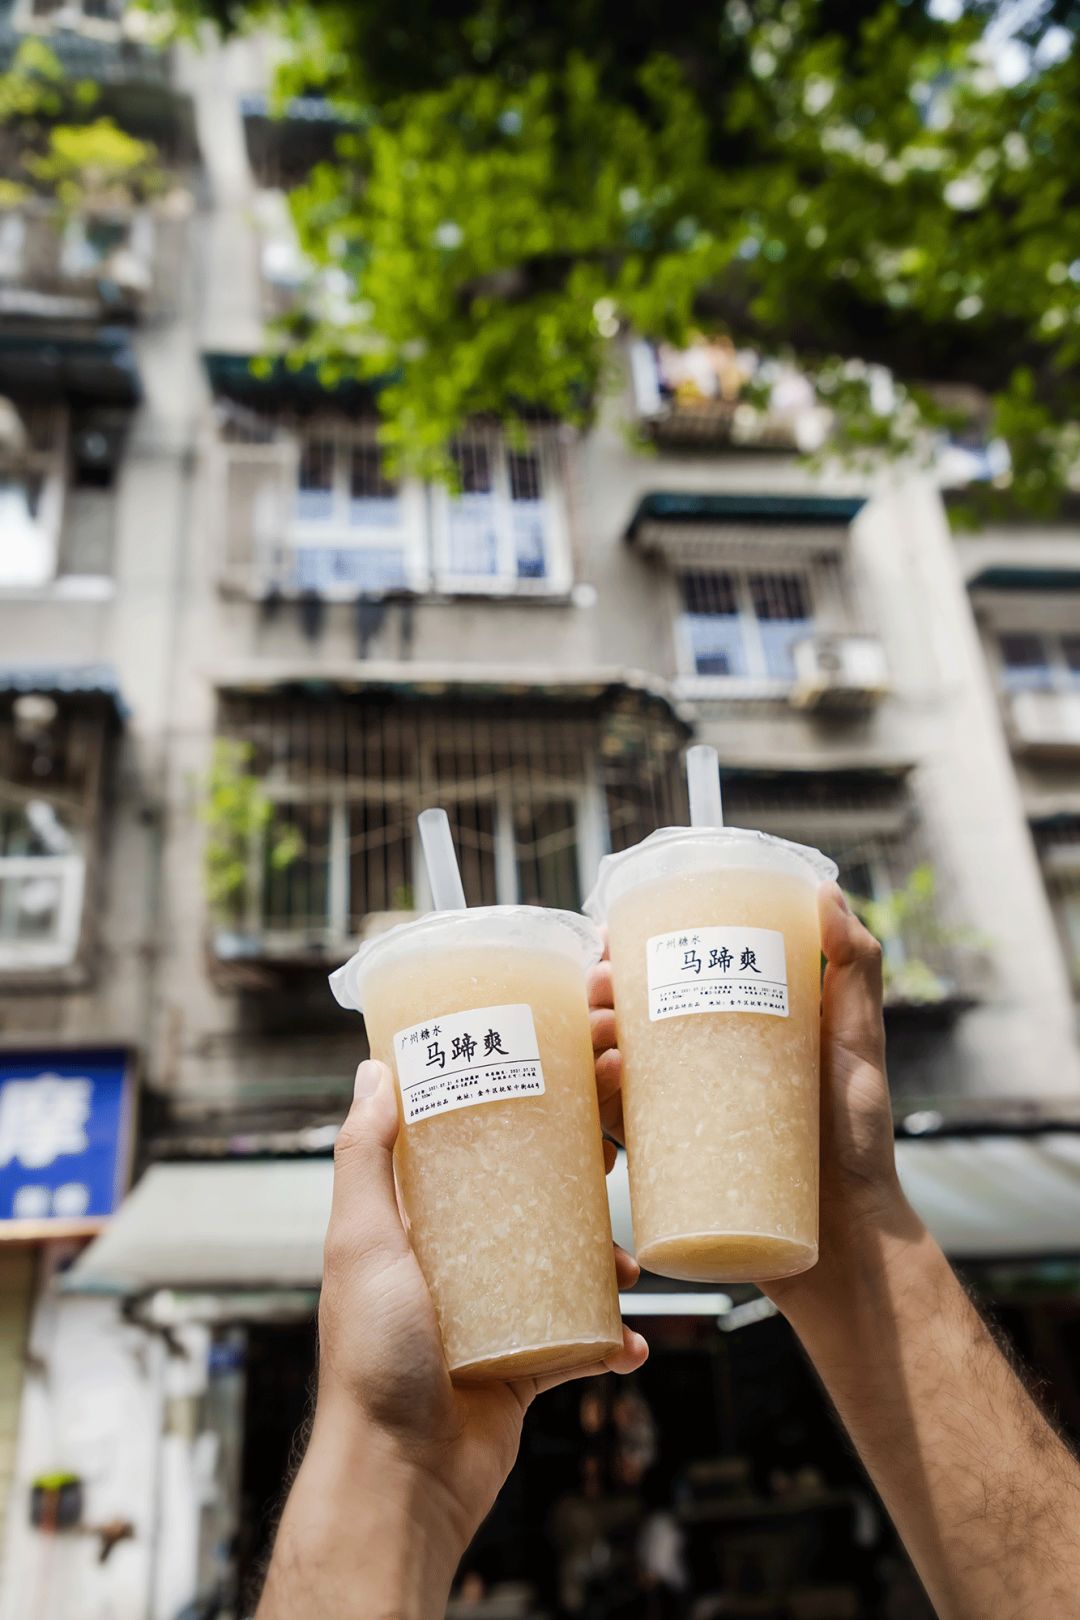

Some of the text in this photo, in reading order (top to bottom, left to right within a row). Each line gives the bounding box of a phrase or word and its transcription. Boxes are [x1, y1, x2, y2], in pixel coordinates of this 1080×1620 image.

[656, 934, 701, 952] 广州糖水
[681, 946, 762, 974] 马蹄爽
[401, 1025, 442, 1050] 广州糖水
[426, 1028, 509, 1068] 马蹄爽
